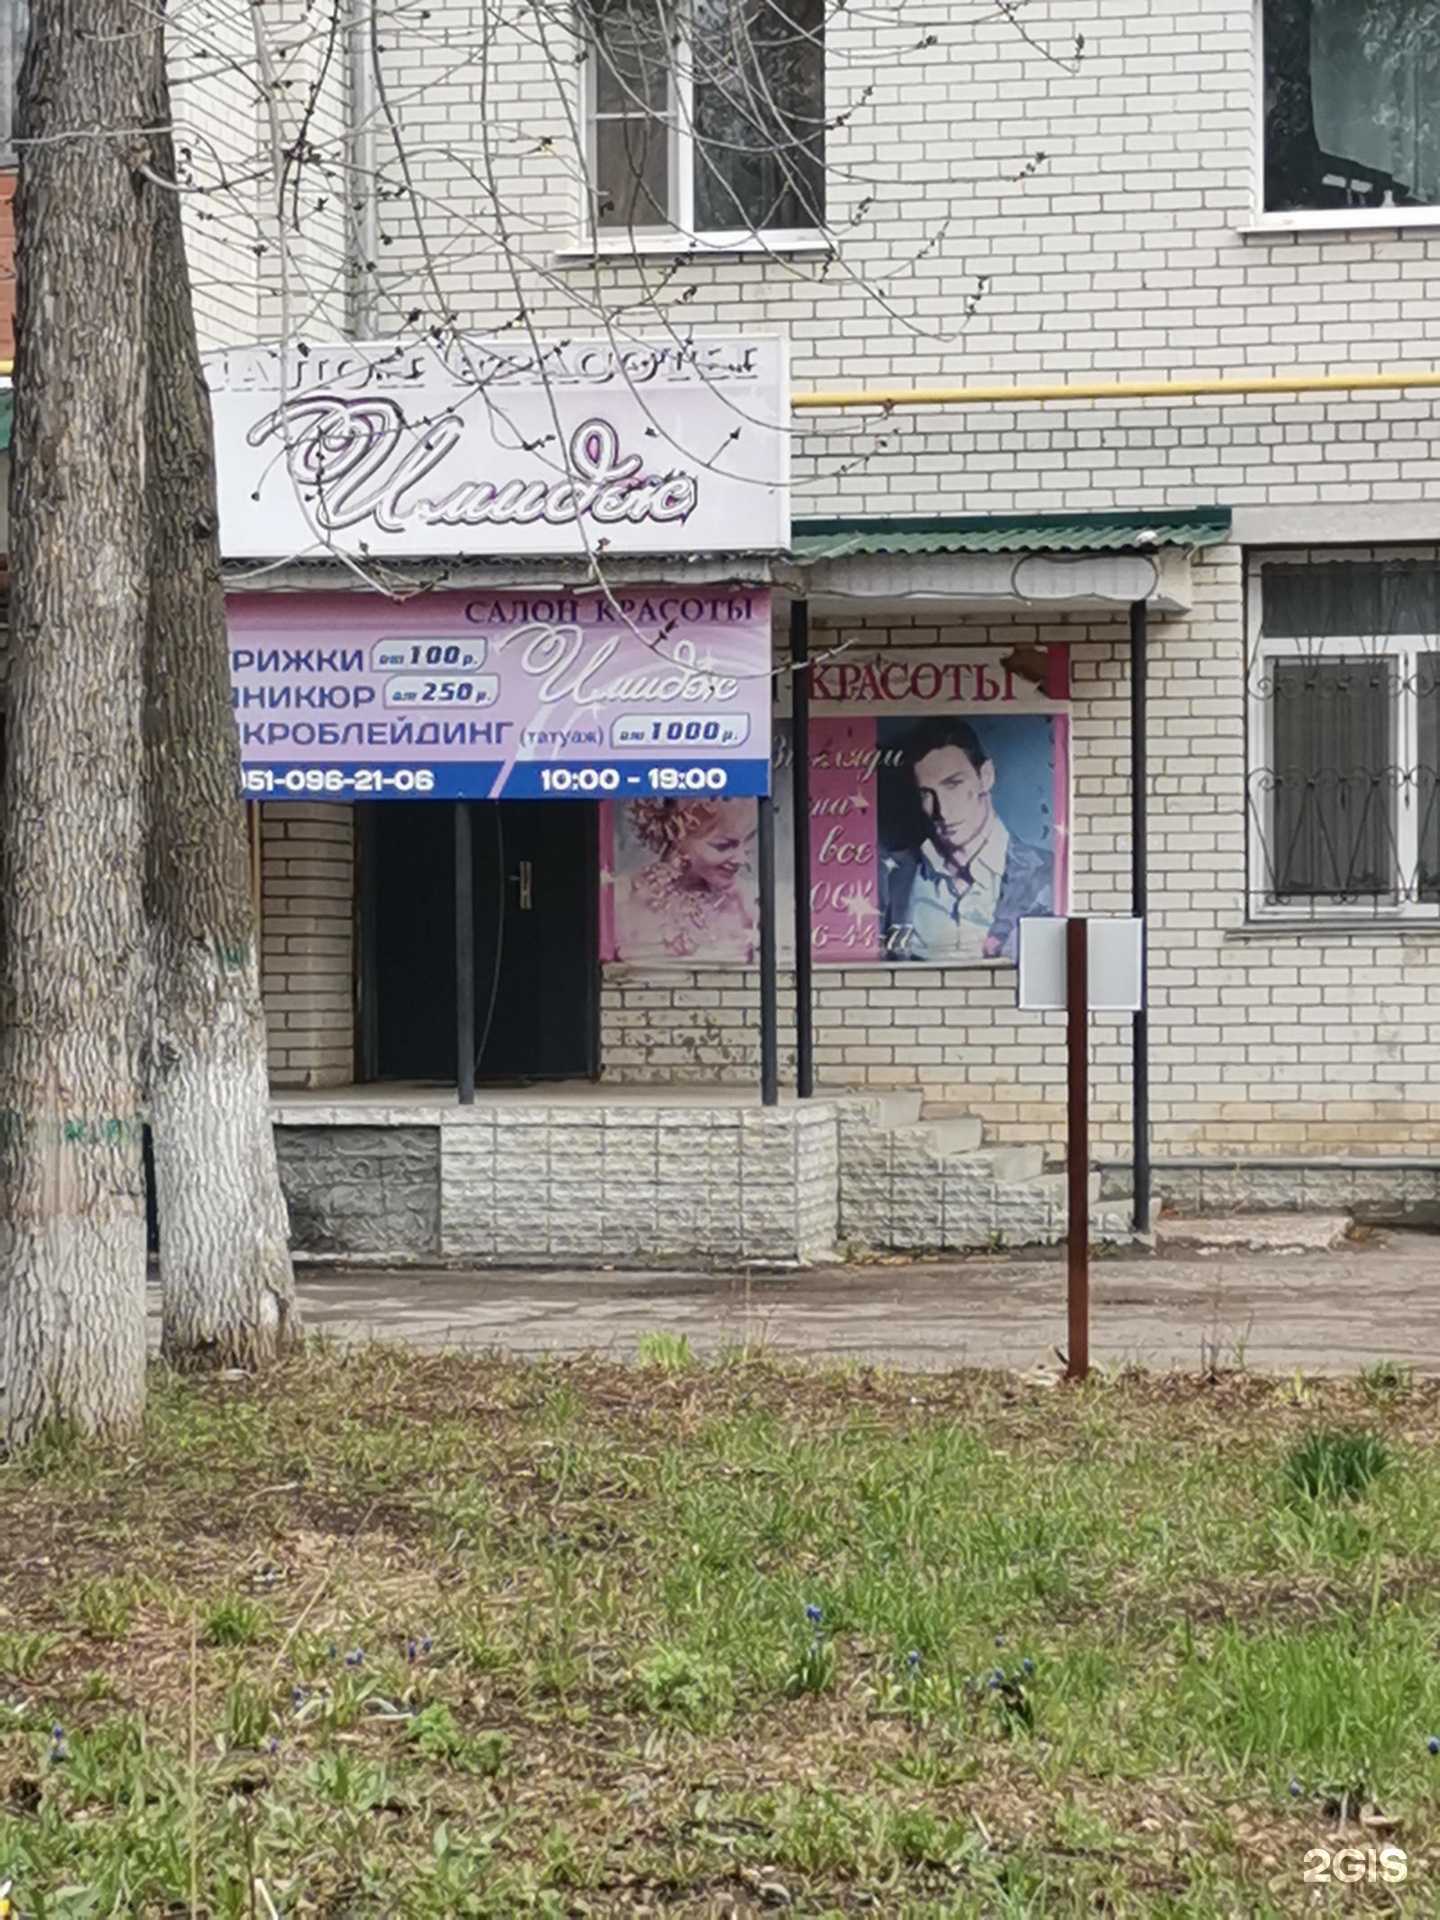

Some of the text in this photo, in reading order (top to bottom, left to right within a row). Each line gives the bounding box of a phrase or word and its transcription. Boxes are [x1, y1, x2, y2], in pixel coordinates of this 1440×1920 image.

[465, 597, 753, 624] САЛОН КРАСОТЫ
[232, 649, 363, 672] РИЖКИ
[410, 645, 461, 665] 100
[232, 685, 376, 709] НИКЮР
[421, 682, 473, 701] 250
[808, 663, 1017, 702] КРАСОТЫ
[243, 715, 514, 746] КРОБЛЕЙДИНГ
[519, 727, 604, 748] (татуаж)
[650, 722, 720, 741] 1000
[241, 769, 435, 792] 51-096-21-06
[540, 768, 621, 791] 10:00
[647, 767, 728, 791] 19:00
[818, 824, 875, 865] все
